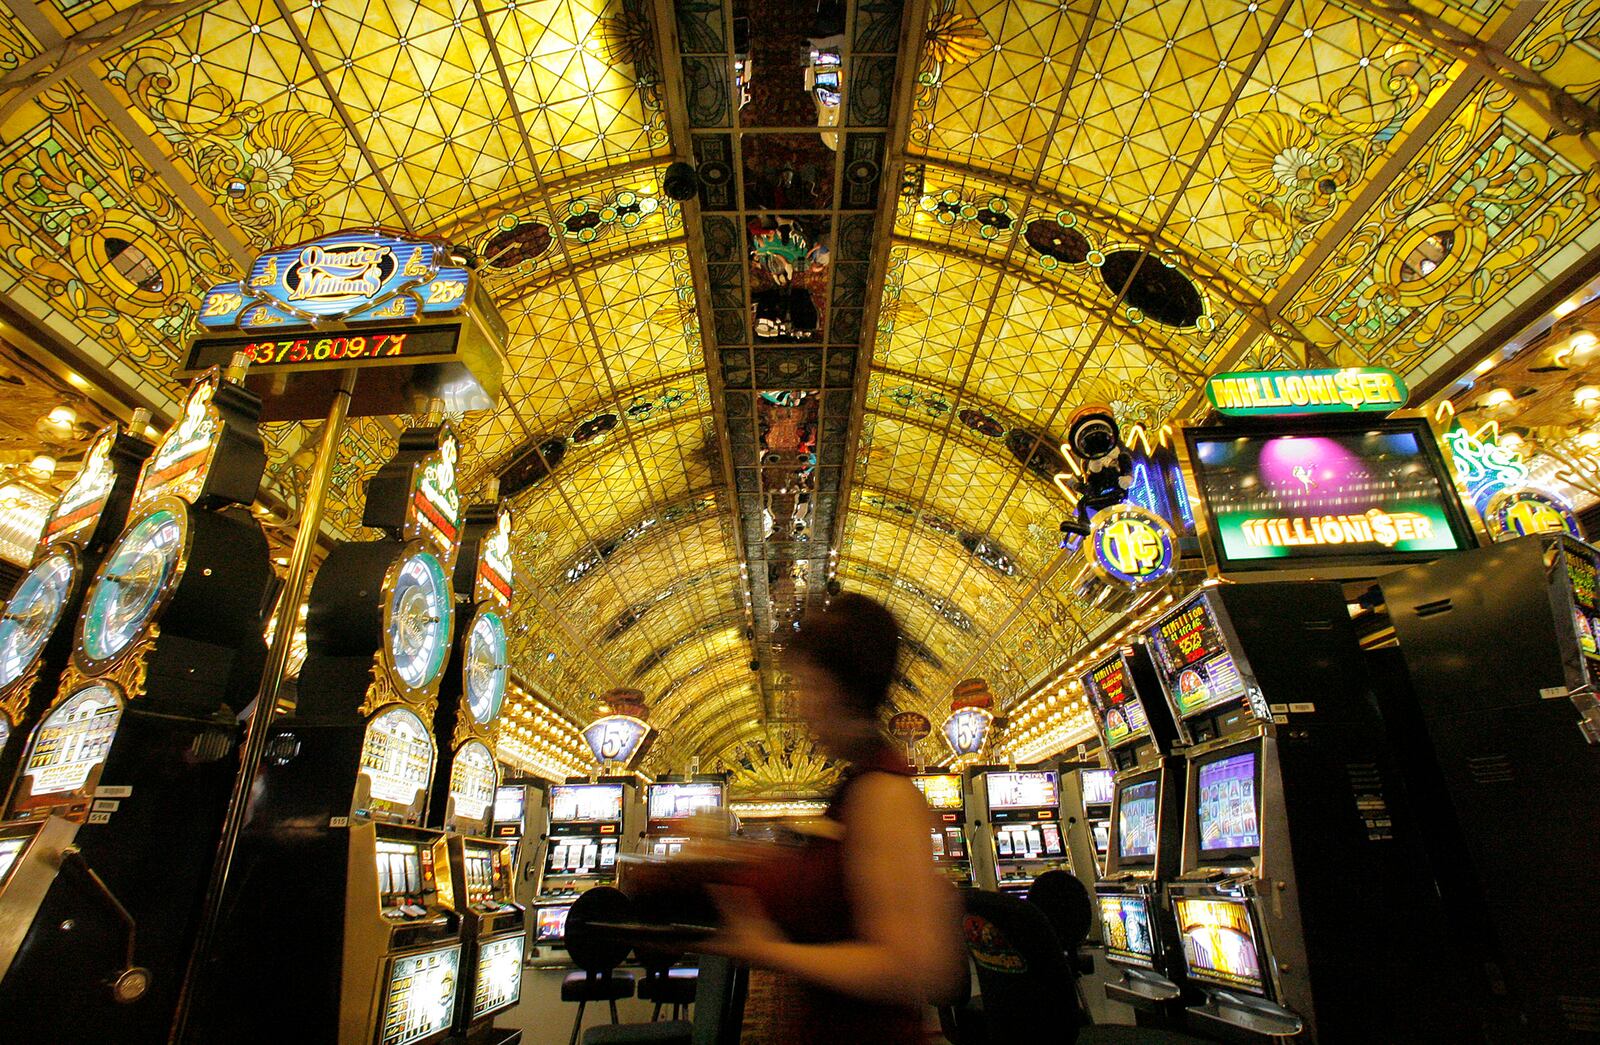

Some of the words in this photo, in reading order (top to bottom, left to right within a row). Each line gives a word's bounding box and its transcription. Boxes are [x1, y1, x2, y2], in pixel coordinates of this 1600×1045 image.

[300, 246, 390, 273] Quarter
[205, 293, 243, 316] 25¢
[428, 280, 464, 303] 25¢
[1211, 368, 1402, 410] MILLIONI$ER
[1240, 508, 1434, 547] MILLIONI$ER
